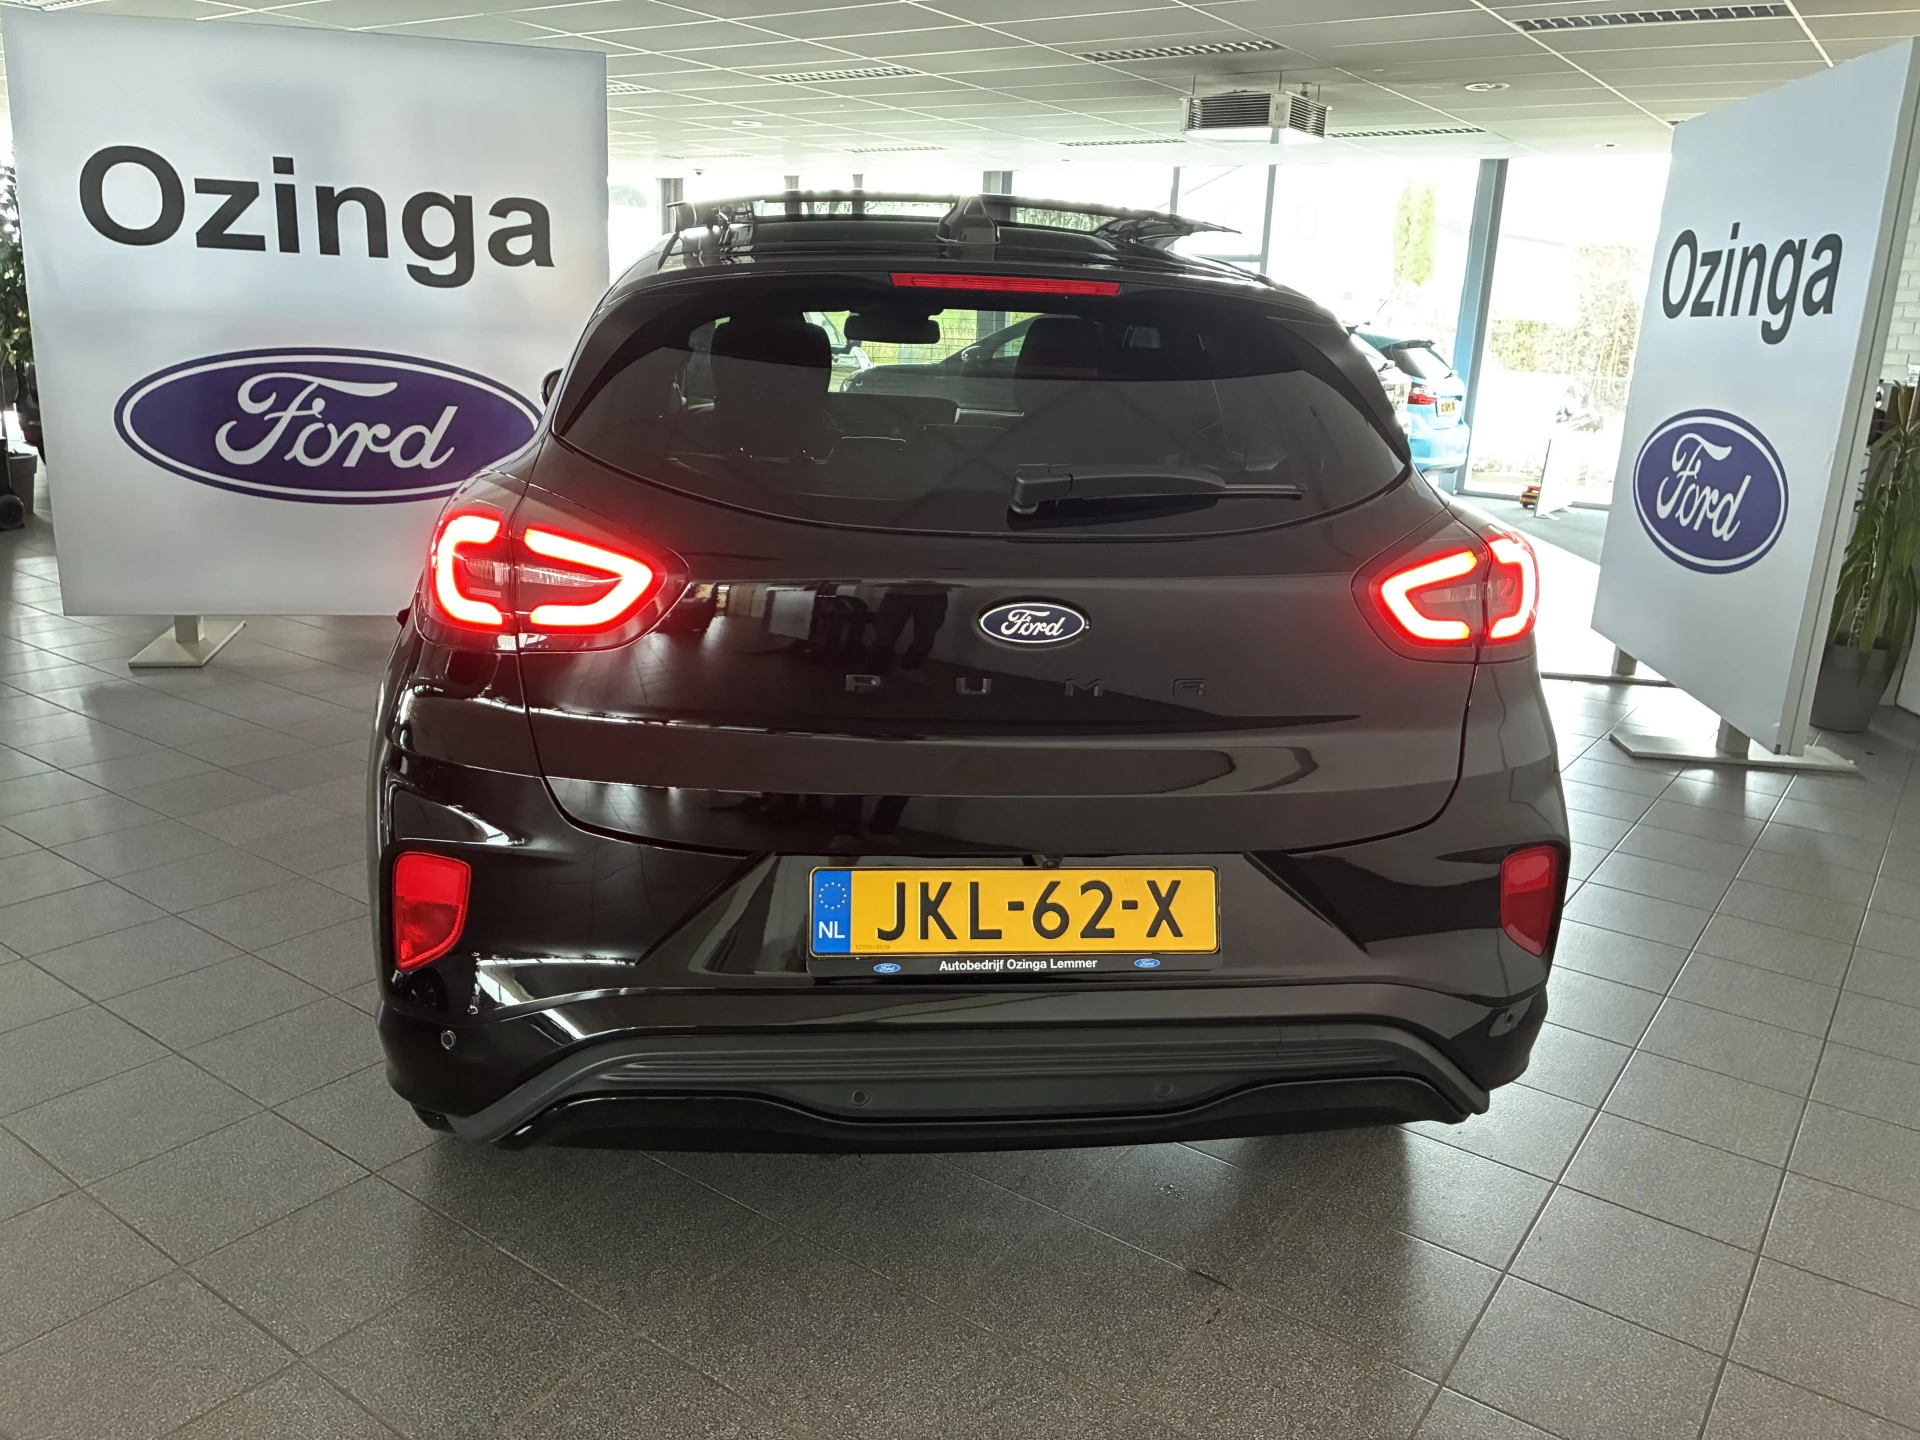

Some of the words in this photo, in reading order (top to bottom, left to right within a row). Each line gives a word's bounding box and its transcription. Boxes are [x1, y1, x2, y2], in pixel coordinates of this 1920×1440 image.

[79, 145, 555, 289] Ozinga
[1662, 222, 1844, 345] Ozinga
[215, 373, 456, 470] Ford
[1656, 433, 1752, 542] Ford
[1000, 609, 1066, 637] Ford
[845, 674, 1208, 697] PUMA
[818, 920, 846, 940] NL
[875, 879, 1184, 942] JKL-62-X
[939, 959, 1003, 972] Autobedrijf
[1006, 959, 1047, 971] Ozinga
[1050, 958, 1097, 969] Lemmer
